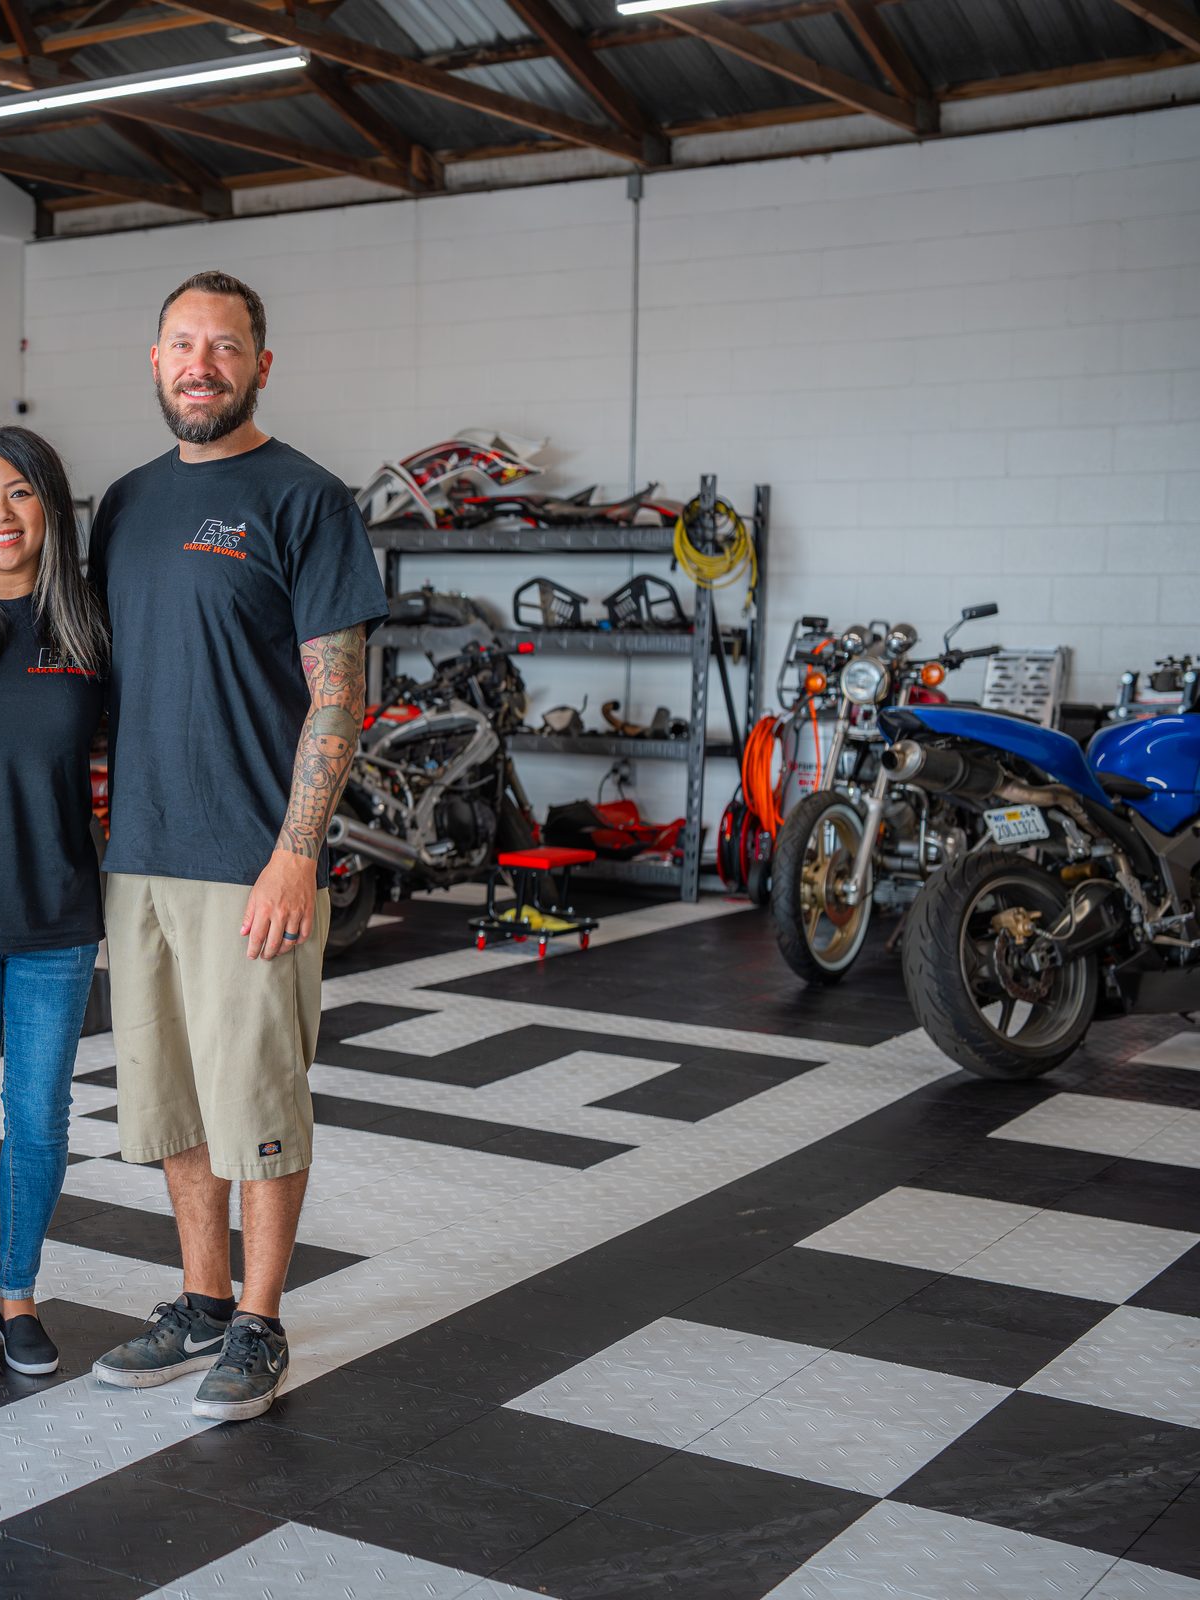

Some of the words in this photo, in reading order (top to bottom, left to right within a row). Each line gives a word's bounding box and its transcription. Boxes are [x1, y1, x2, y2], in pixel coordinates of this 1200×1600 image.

[192, 518, 241, 549] EMS
[183, 542, 213, 552] GARAGE
[213, 546, 247, 560] WORKS
